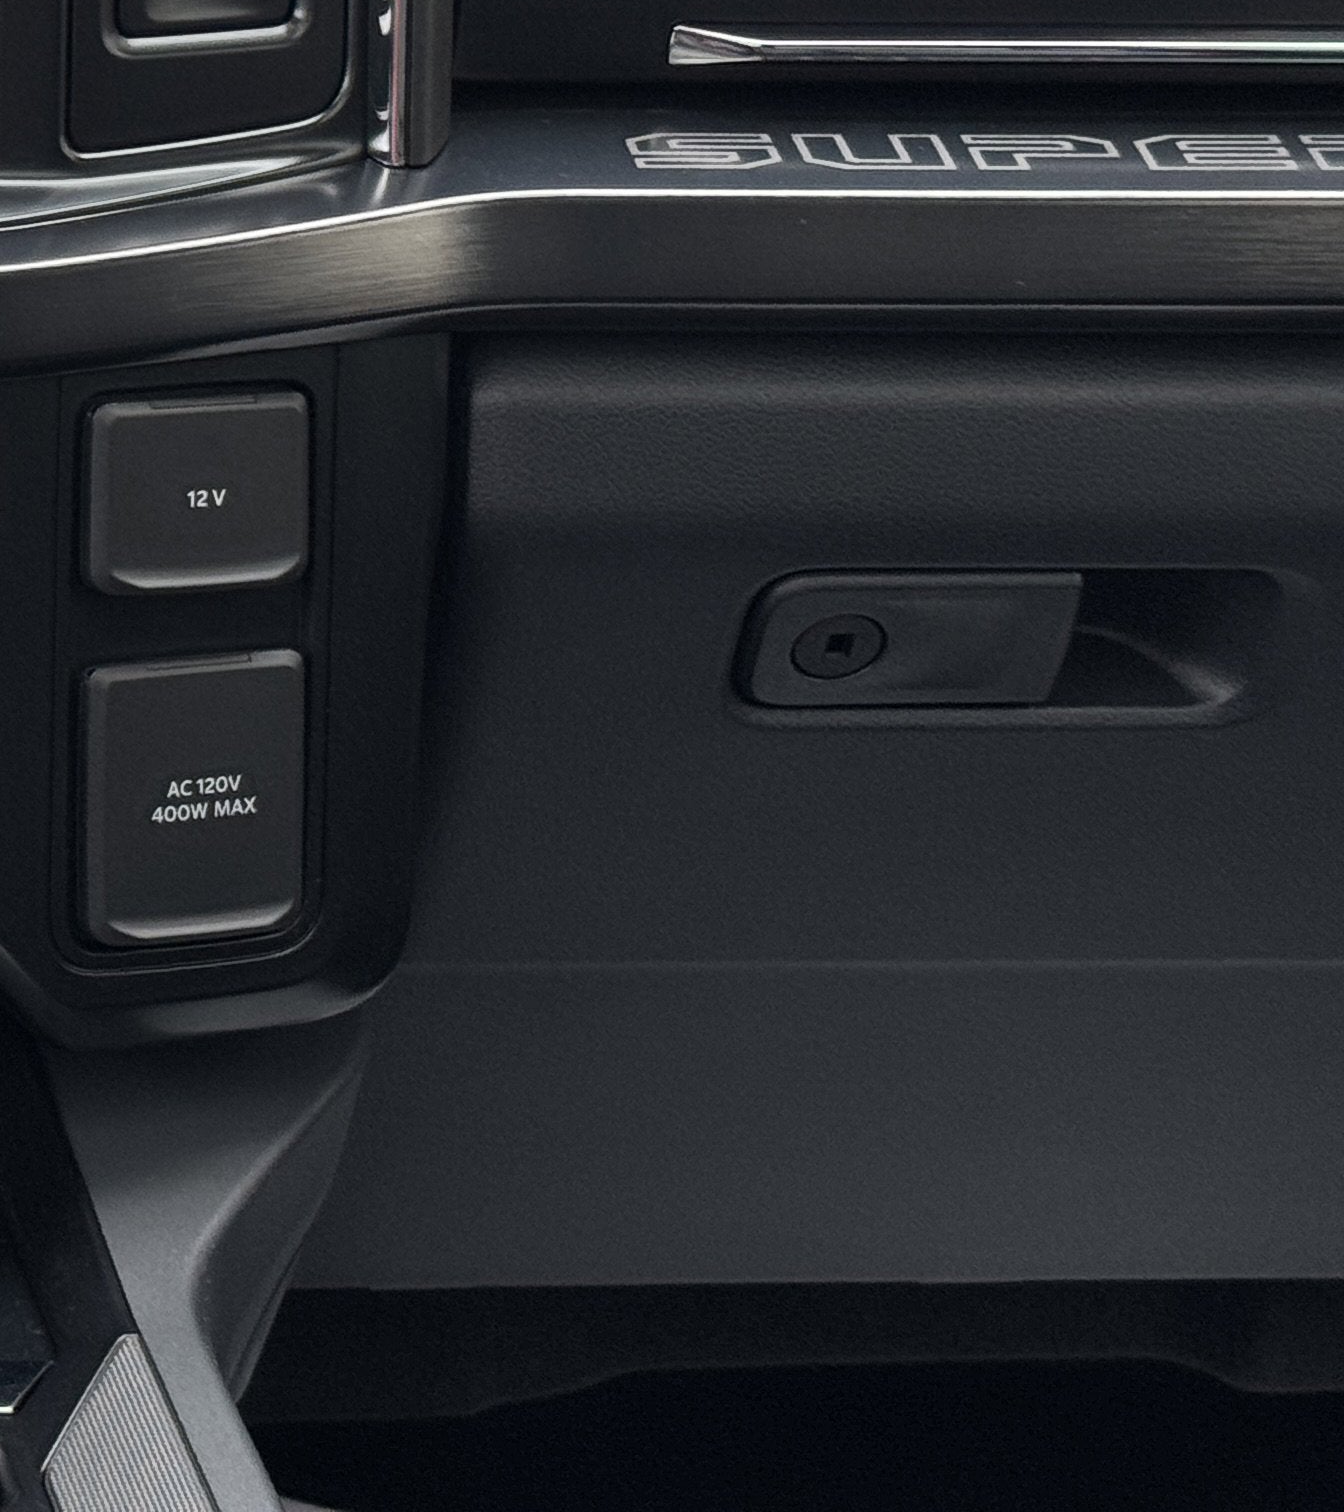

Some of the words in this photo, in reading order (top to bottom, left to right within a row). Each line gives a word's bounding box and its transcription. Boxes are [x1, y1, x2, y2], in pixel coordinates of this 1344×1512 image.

[624, 132, 1344, 172] SUPE
[187, 489, 209, 508] 12
[211, 488, 227, 507] V
[166, 779, 193, 798] AC
[195, 774, 242, 795] 120V
[151, 802, 209, 824] 400W
[214, 796, 257, 818] MAX
